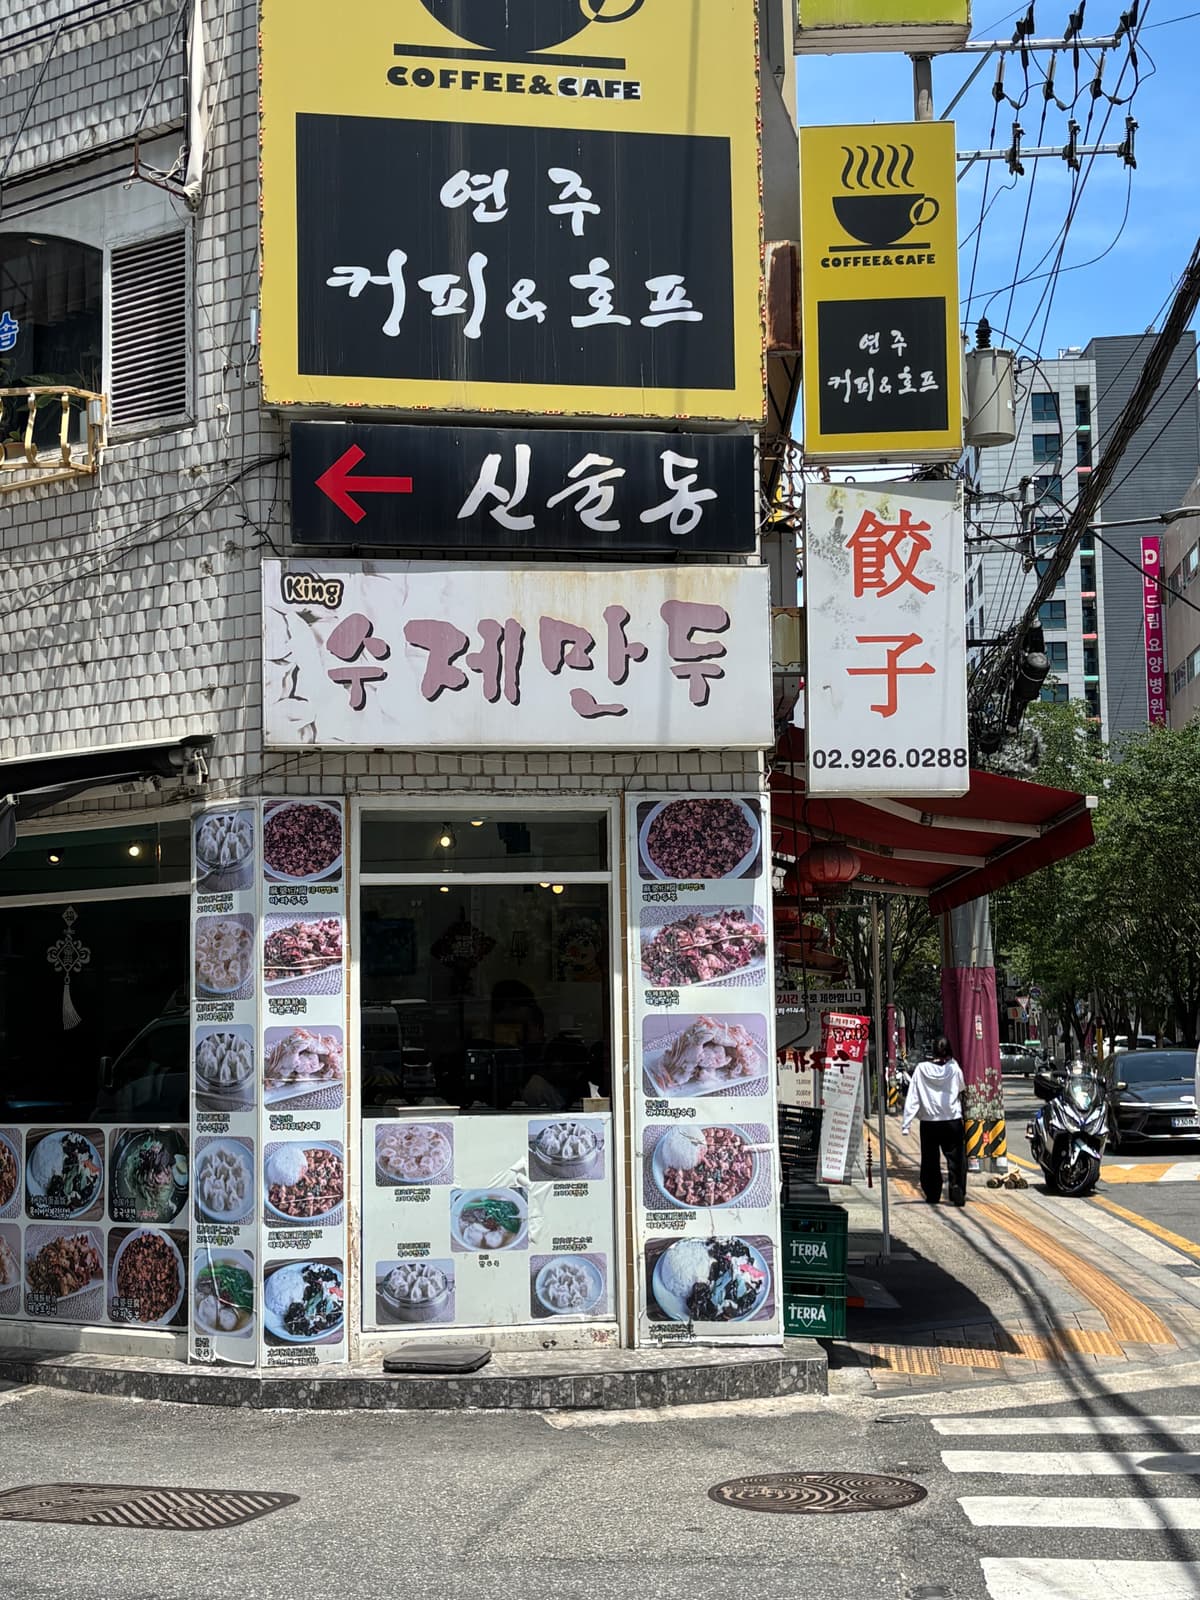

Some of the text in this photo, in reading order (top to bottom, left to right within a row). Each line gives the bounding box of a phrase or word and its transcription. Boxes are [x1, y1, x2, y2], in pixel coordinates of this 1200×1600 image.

[387, 66, 641, 100] COFFEE&CAFE
[821, 254, 936, 268] COFFEE&CAFE
[283, 574, 342, 609] King
[326, 600, 732, 720] 수제만두
[812, 749, 969, 770] 02.926.0288
